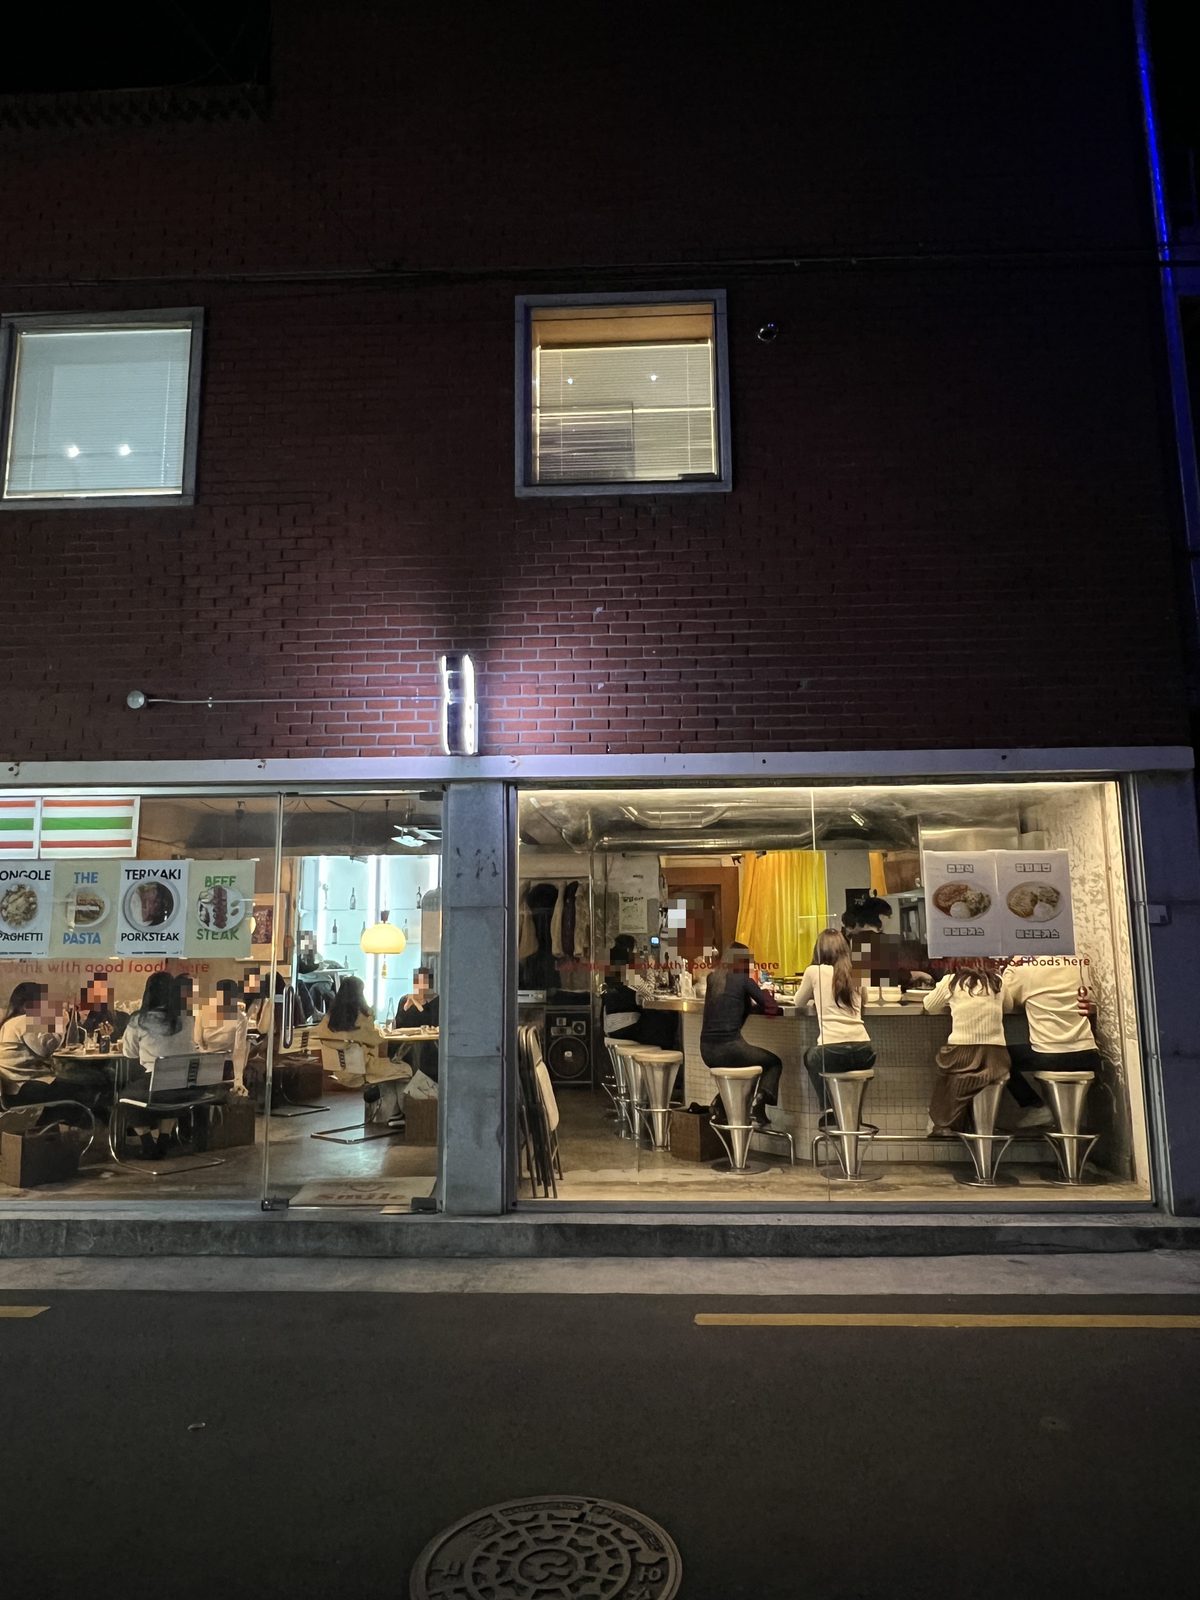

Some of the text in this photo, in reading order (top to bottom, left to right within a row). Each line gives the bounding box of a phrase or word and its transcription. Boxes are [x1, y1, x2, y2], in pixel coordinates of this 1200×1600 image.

[74, 872, 99, 884] THE
[125, 869, 181, 880] TERIYAKI
[204, 876, 236, 887] BEEF
[63, 932, 101, 944] PASTA
[120, 932, 180, 942] PORKSTEAK
[196, 929, 240, 941] STEAK
[1064, 956, 1090, 966] here
[48, 960, 81, 974] with
[85, 960, 124, 975] good
